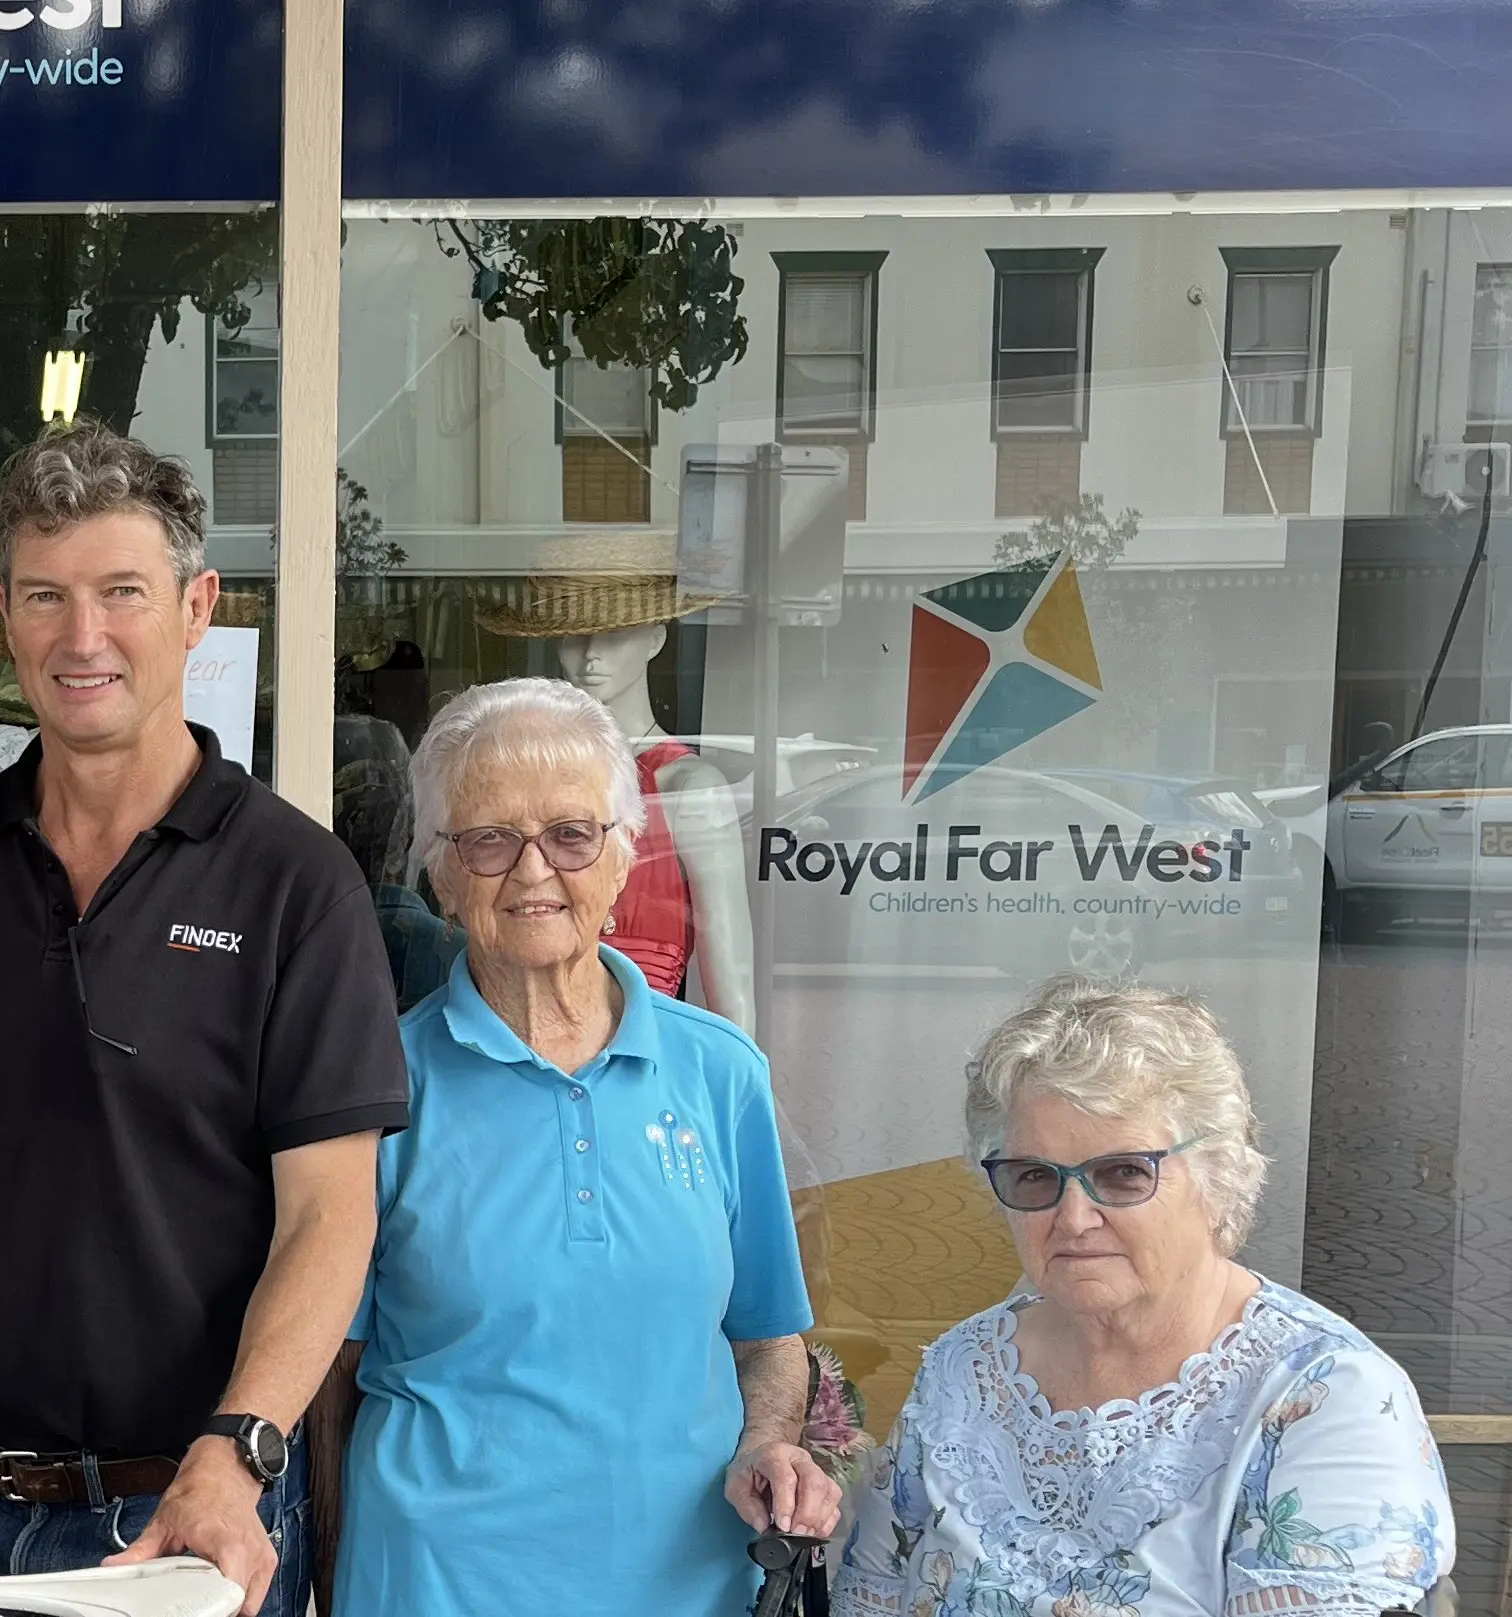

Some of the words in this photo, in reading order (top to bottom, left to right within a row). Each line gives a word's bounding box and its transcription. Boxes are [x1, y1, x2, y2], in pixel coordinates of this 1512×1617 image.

[758, 824, 929, 895] Royal
[946, 825, 1055, 882] Far
[1067, 824, 1251, 882] West
[869, 892, 978, 913] Children's
[987, 892, 1065, 915] health,
[1073, 892, 1241, 920] country-wide
[169, 924, 243, 953] FINDEX
